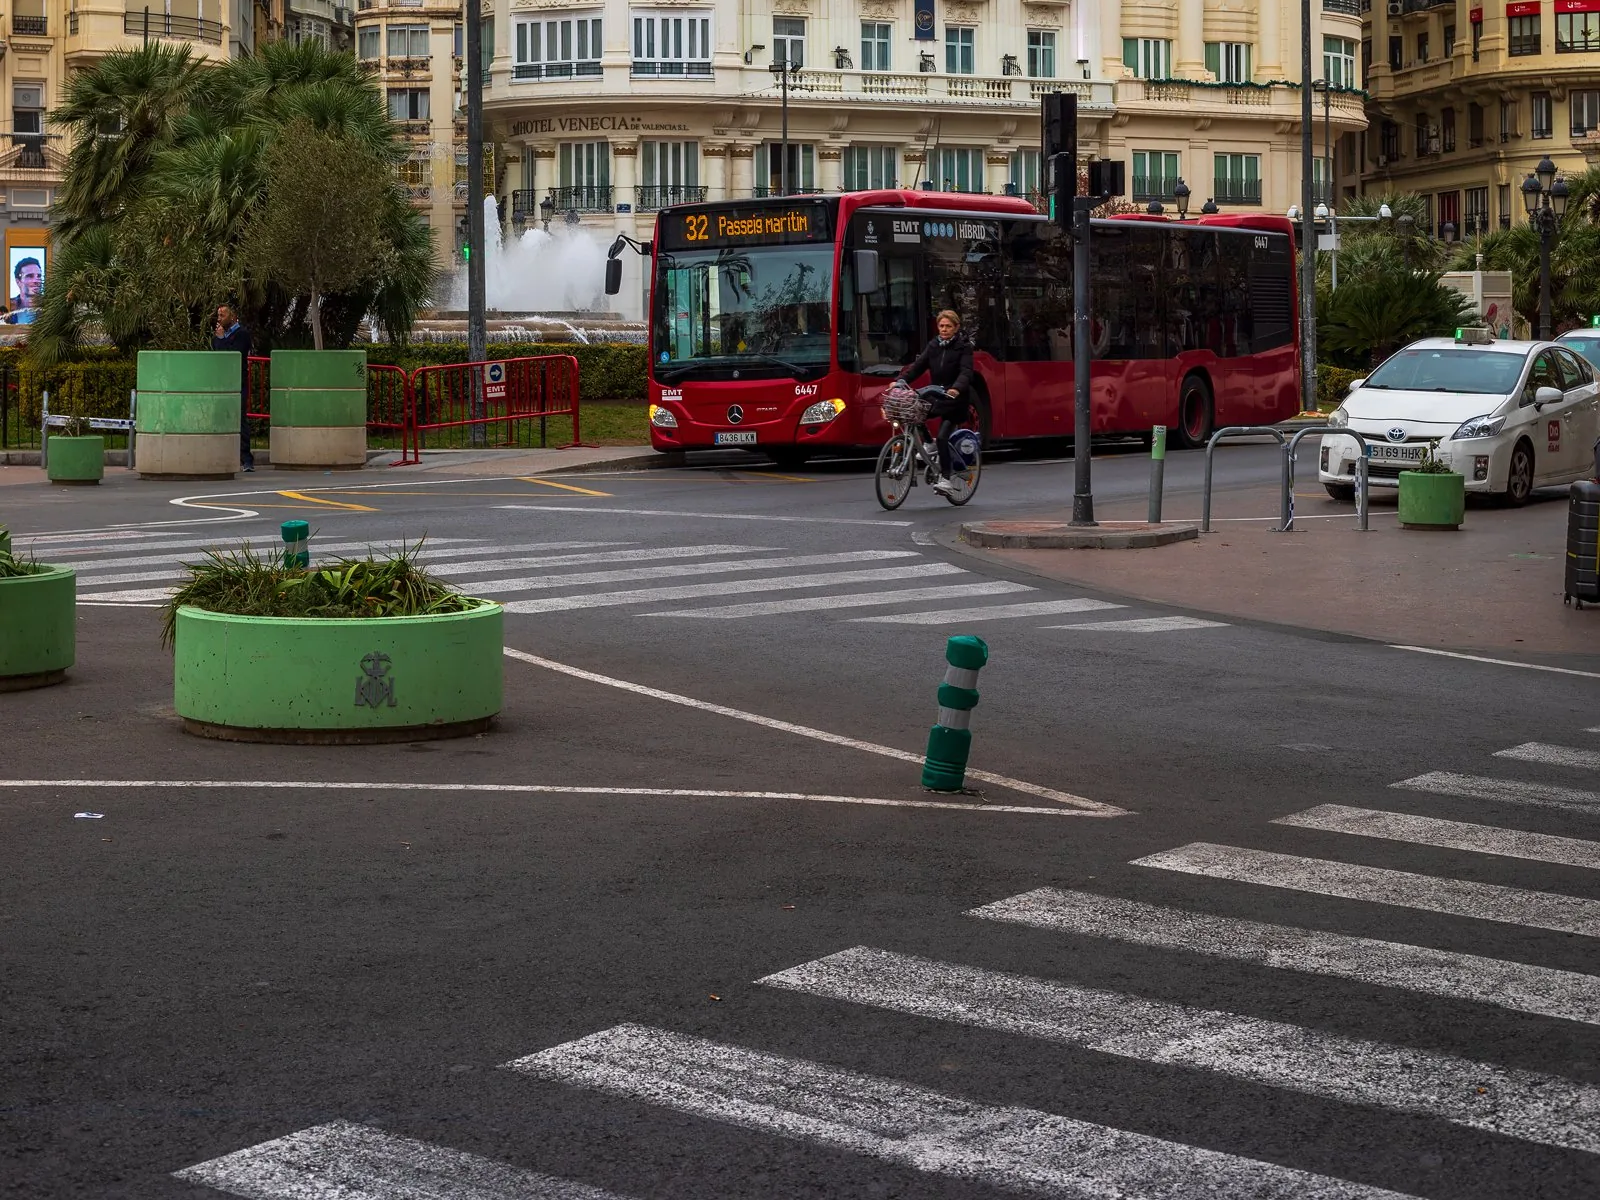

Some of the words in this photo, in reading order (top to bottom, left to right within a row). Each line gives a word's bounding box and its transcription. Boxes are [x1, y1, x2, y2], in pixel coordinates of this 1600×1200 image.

[518, 119, 556, 136] HOTEL
[558, 116, 630, 132] VENECIA
[630, 123, 640, 131] DE
[686, 214, 709, 241] 32
[718, 214, 763, 237] Passeig
[765, 211, 808, 233] marítim
[892, 220, 920, 233] EMT
[959, 220, 986, 240] HÍBRID
[1255, 236, 1268, 249] 6447
[486, 385, 506, 393] EMT
[795, 384, 818, 395] 6447
[719, 432, 739, 443] 8436
[740, 432, 755, 443] LKW
[1372, 446, 1399, 458] 5169
